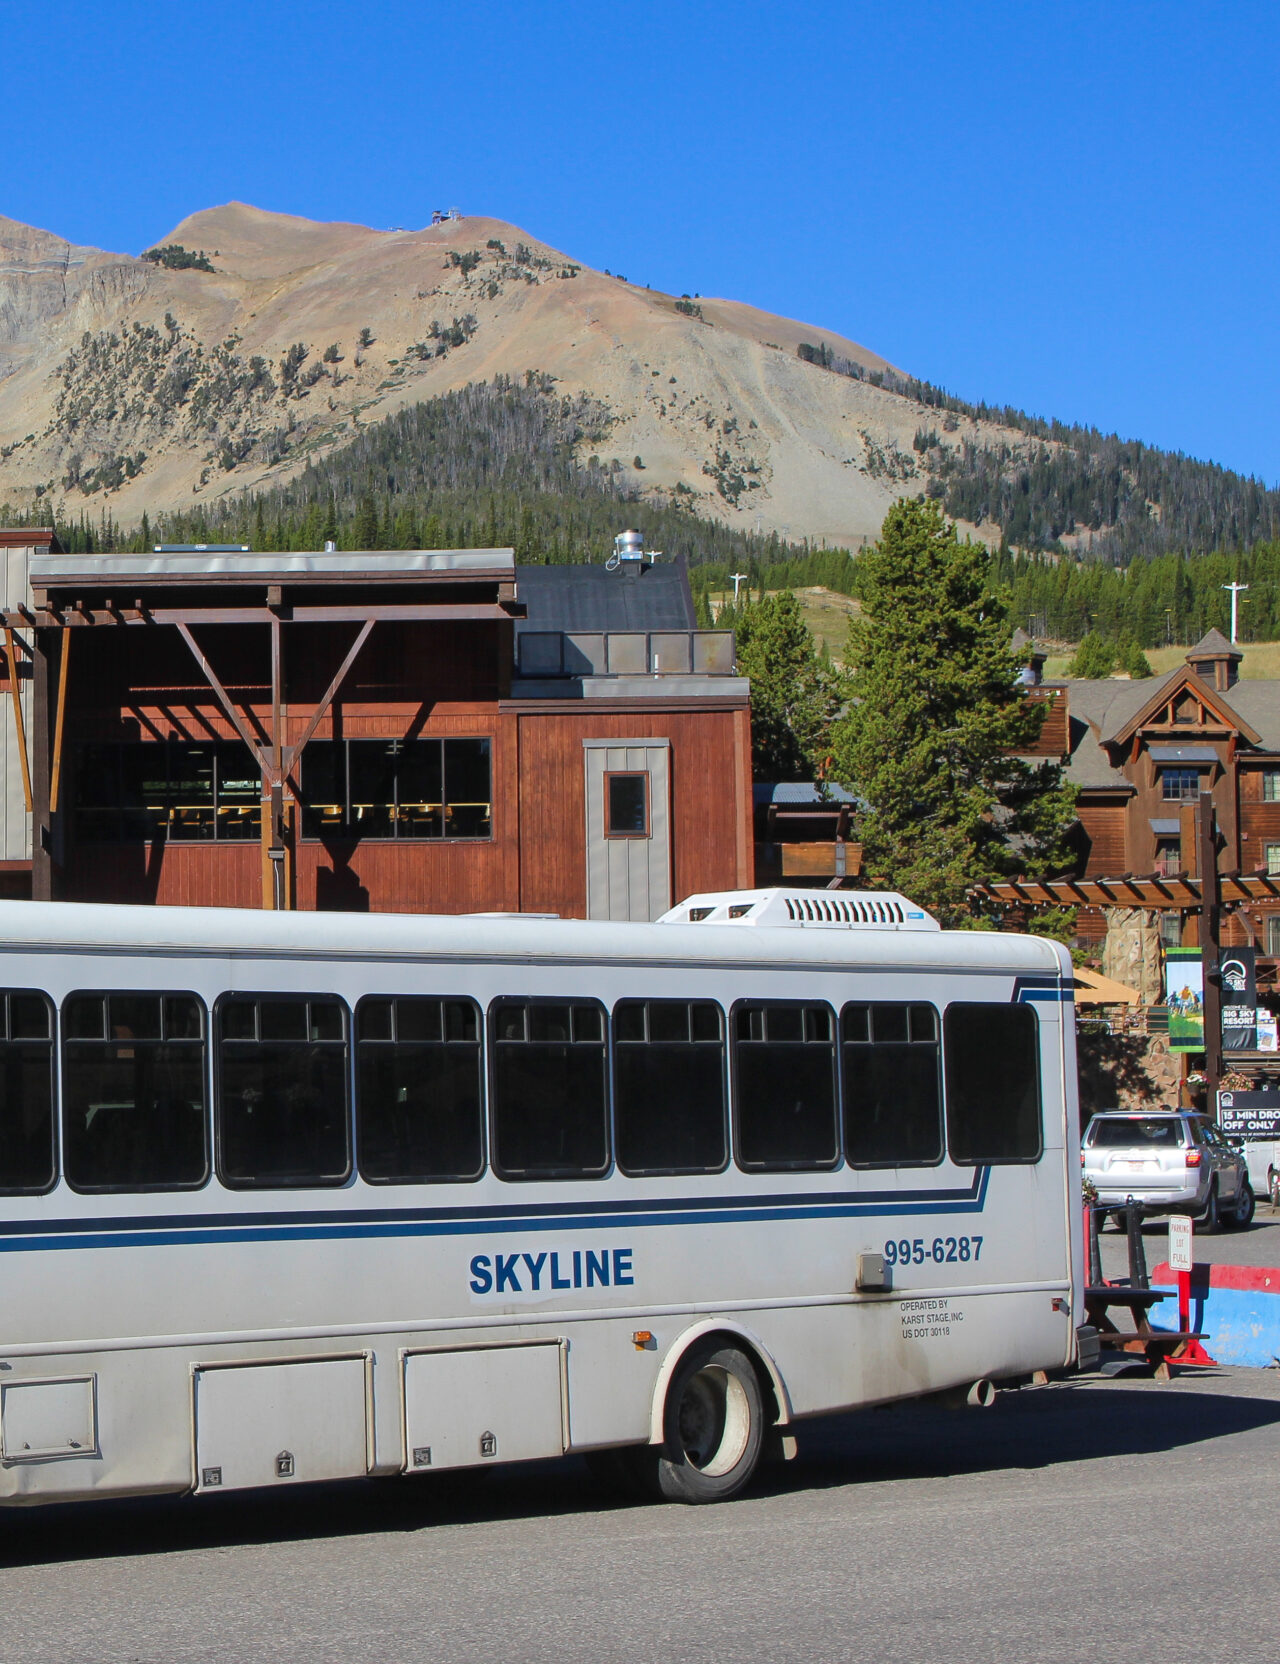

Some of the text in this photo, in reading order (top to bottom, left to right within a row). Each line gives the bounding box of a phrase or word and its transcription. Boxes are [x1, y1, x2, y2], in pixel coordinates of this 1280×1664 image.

[1223, 1111, 1233, 1120] 15
[1236, 1111, 1257, 1120] MIN
[1223, 1121, 1276, 1129] OFF ONLY
[1171, 1223, 1189, 1233] PARKING
[884, 1236, 983, 1266] 995-6287
[1172, 1253, 1188, 1263] FULL
[470, 1248, 634, 1294] SKYLINE
[900, 1300, 948, 1311] OPERATED BY
[901, 1314, 925, 1325] KARST
[902, 1327, 950, 1339] US DOT 30118
